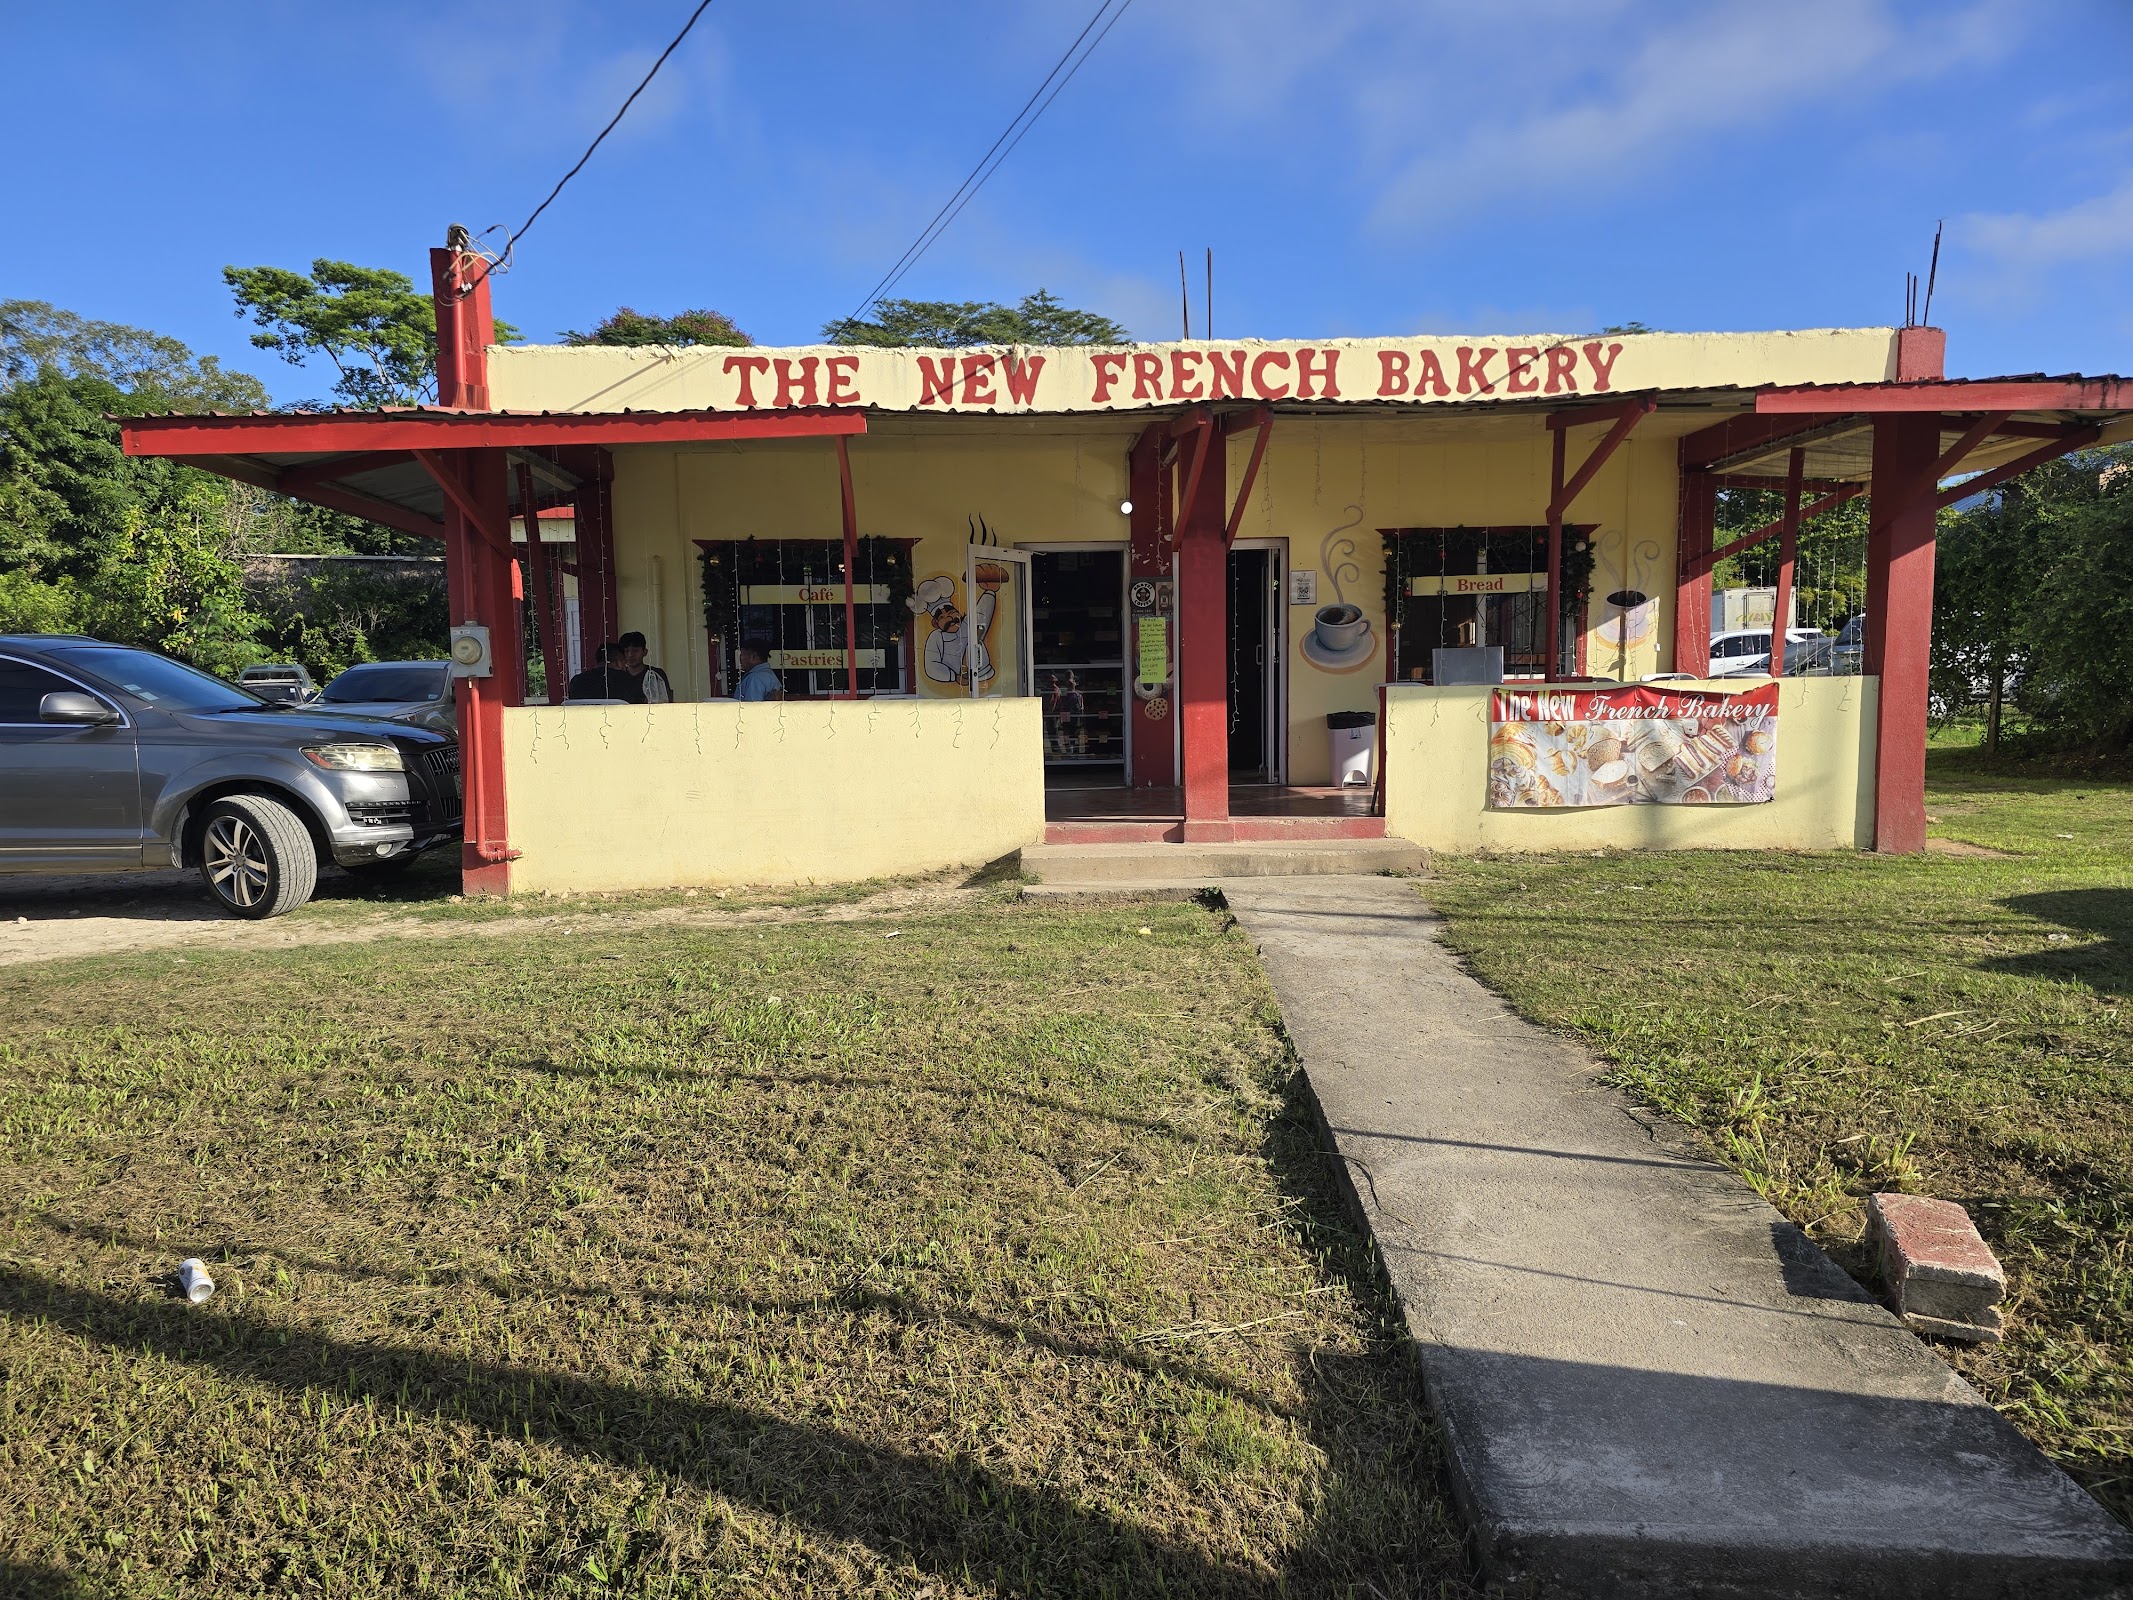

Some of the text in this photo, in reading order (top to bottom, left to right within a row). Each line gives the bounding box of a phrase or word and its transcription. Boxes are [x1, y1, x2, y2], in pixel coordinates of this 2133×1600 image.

[722, 342, 1625, 407] THE NEW FRENCH BAKERY
[1456, 577, 1504, 592] Bread
[779, 652, 844, 667] Pastries
[1498, 688, 1776, 728] The New French Bakery
